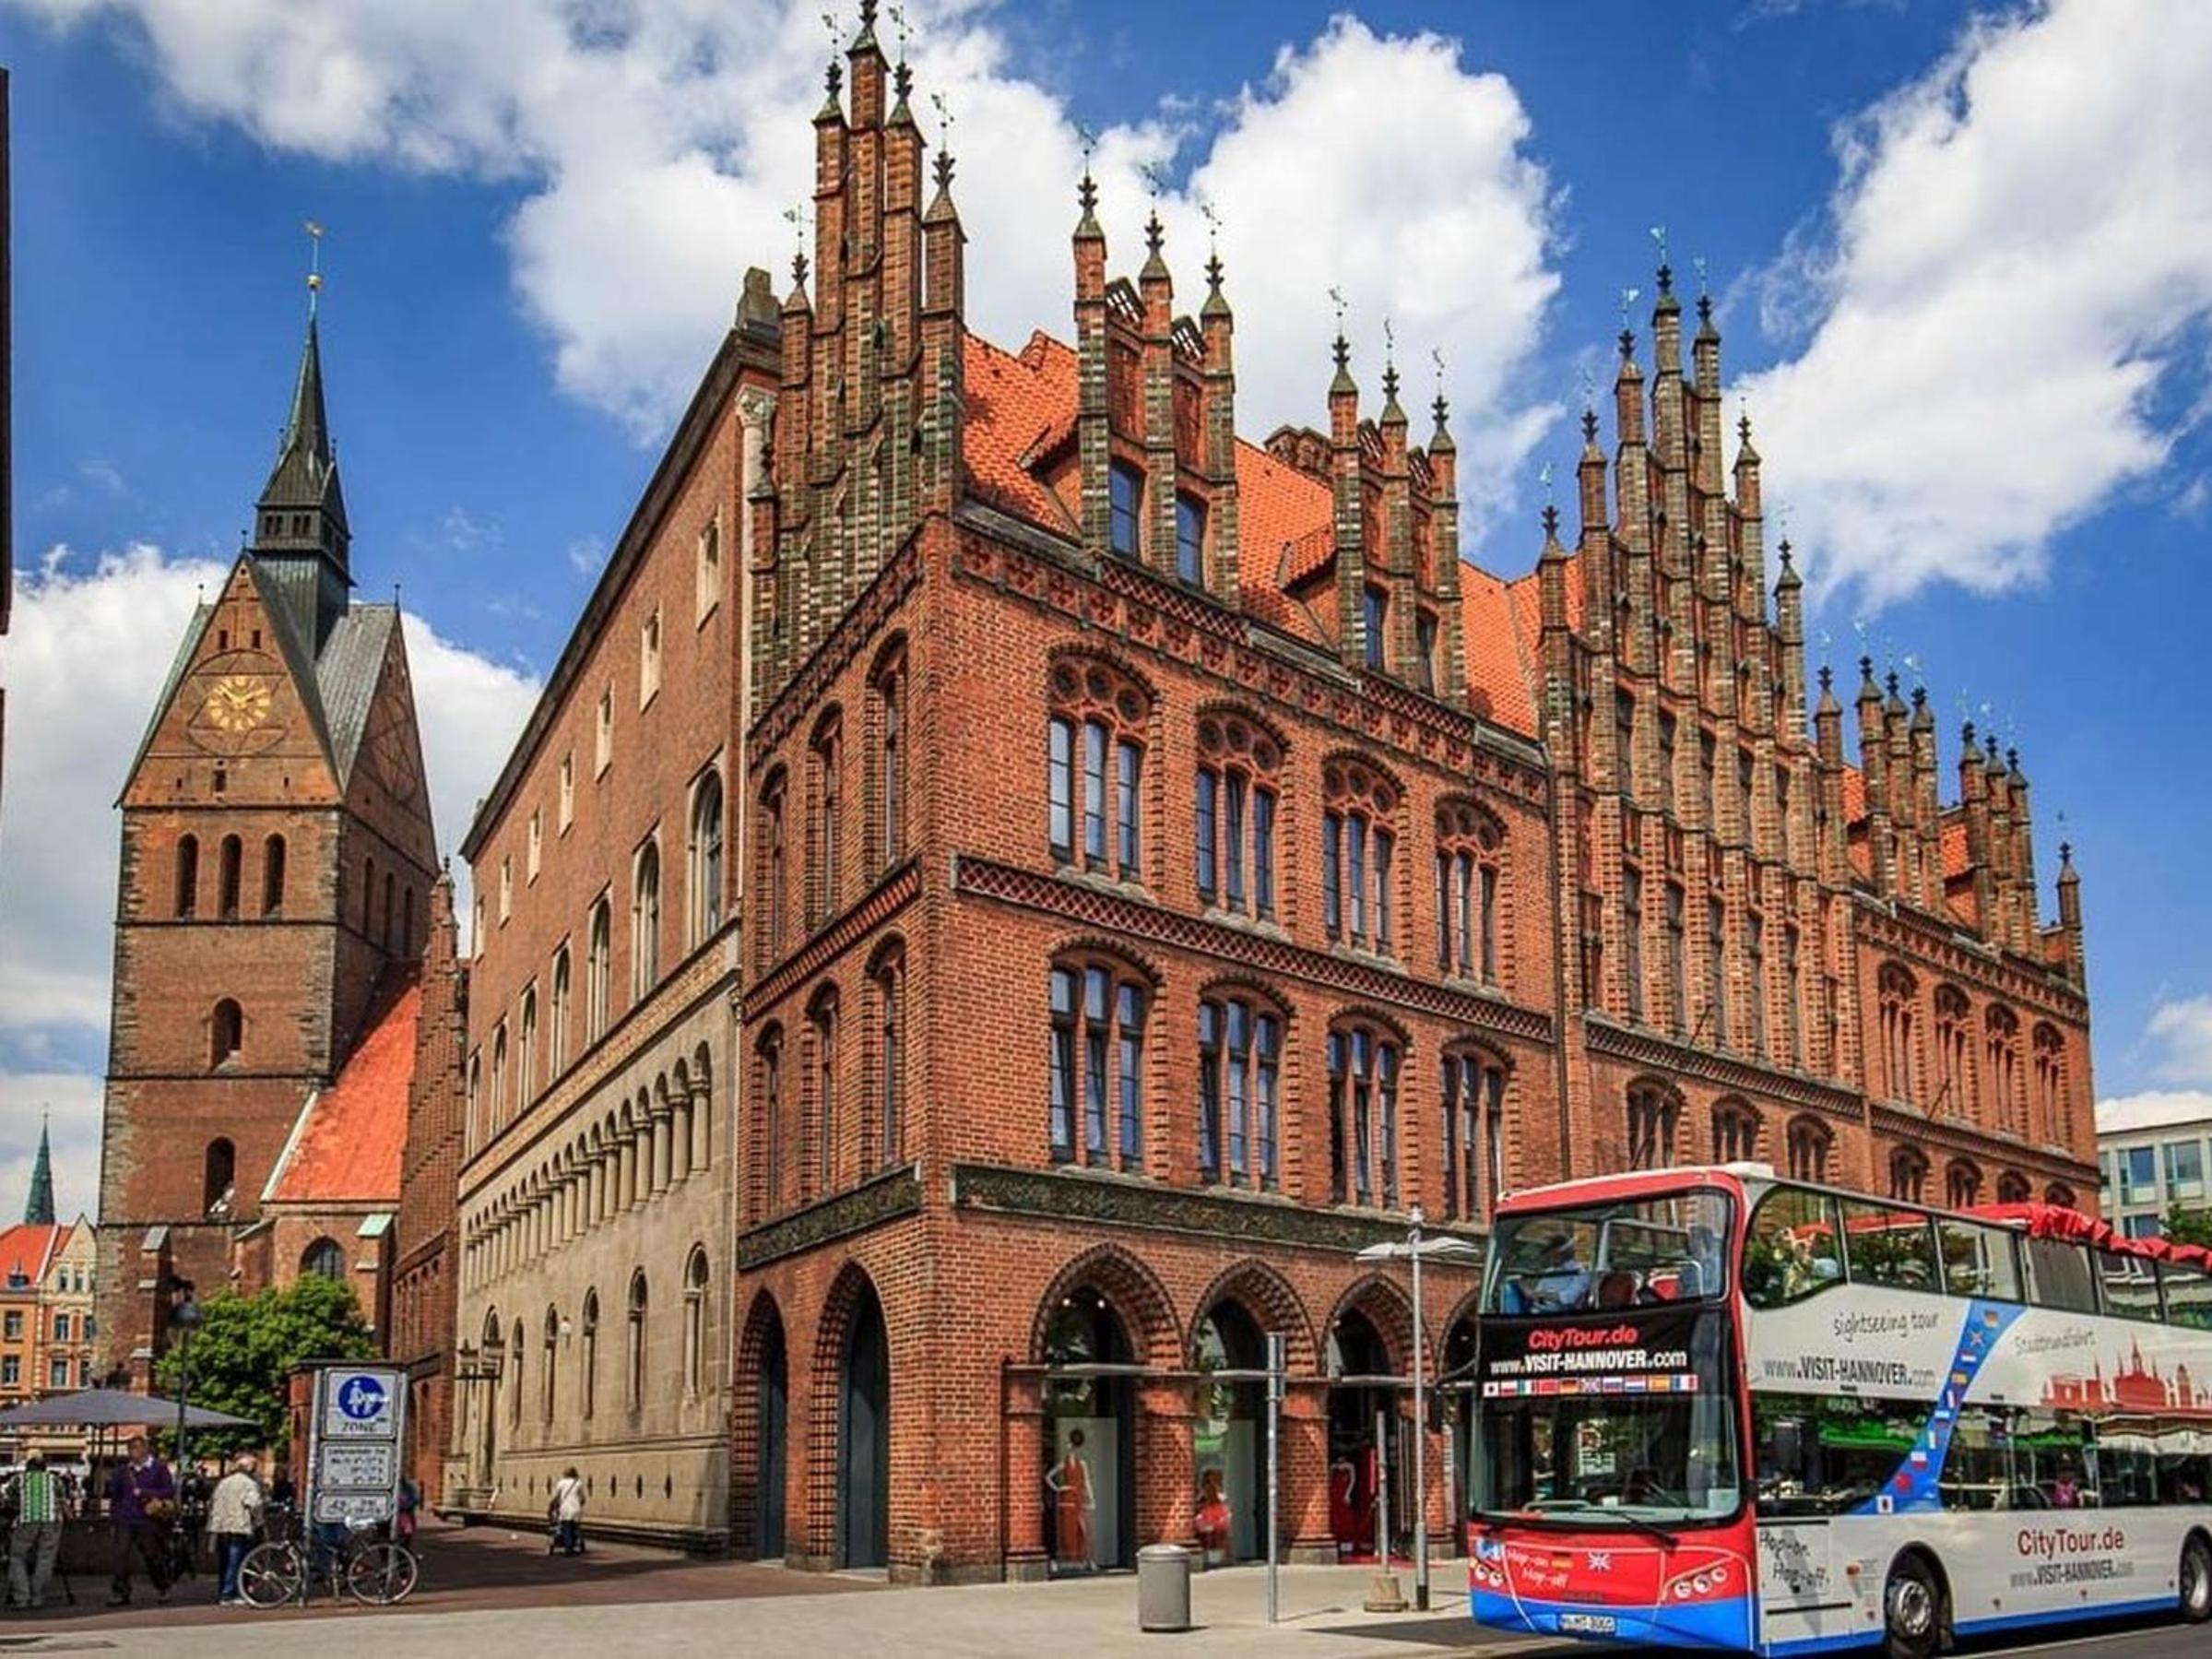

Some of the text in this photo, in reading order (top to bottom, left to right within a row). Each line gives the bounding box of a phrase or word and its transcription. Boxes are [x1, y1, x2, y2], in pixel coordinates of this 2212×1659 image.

[1528, 1324, 1638, 1351] CityTour.de
[1489, 1349, 1688, 1375] www.VISIT-HANNOVER.com
[1763, 1355, 1936, 1388] www.VISIT-HANNOVER.com
[341, 1420, 377, 1432] ZONE
[2017, 1525, 2125, 1560] CityTour.de
